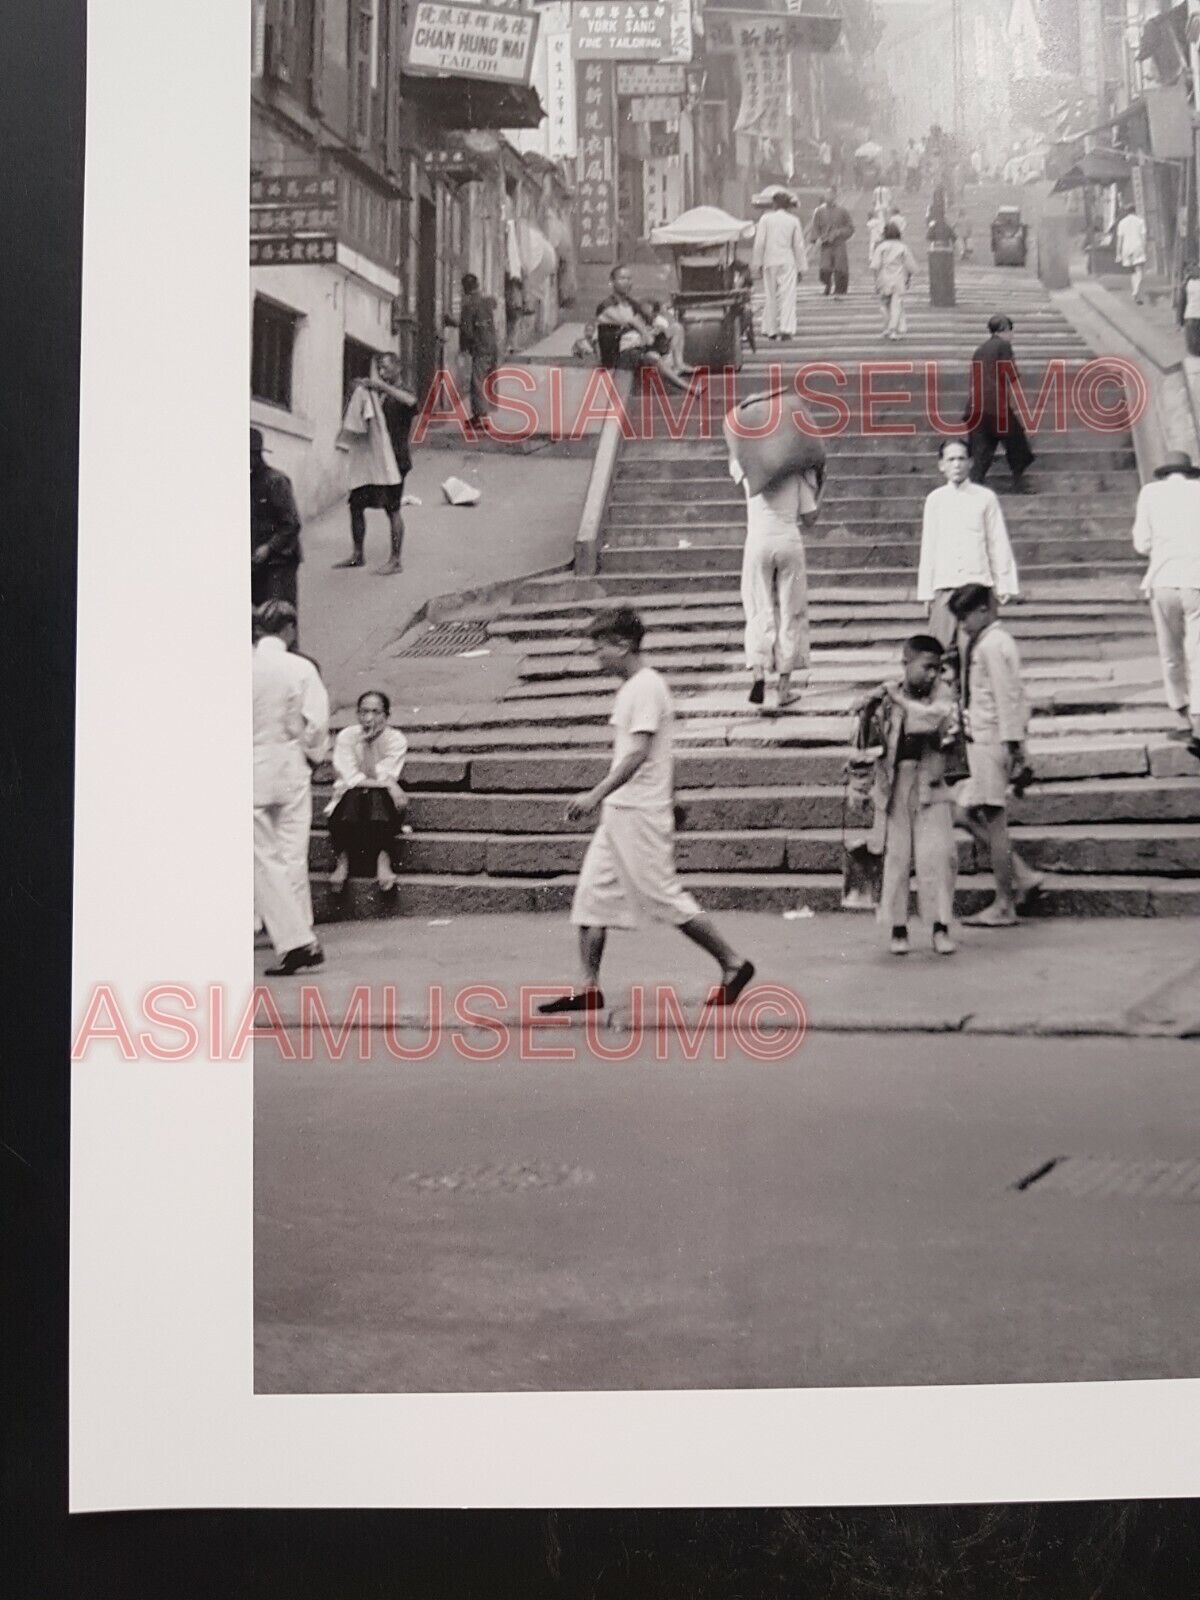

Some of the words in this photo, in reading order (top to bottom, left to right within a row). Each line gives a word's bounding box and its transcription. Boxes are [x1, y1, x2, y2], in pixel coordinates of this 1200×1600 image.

[587, 19, 618, 34] YORK
[625, 19, 657, 34] SANG
[415, 28, 456, 51] CHAN
[458, 32, 499, 56] HUNG
[502, 38, 526, 60] WAI
[578, 36, 603, 49] FINE
[609, 36, 663, 49] TAILORING
[439, 53, 499, 73] TAILOR
